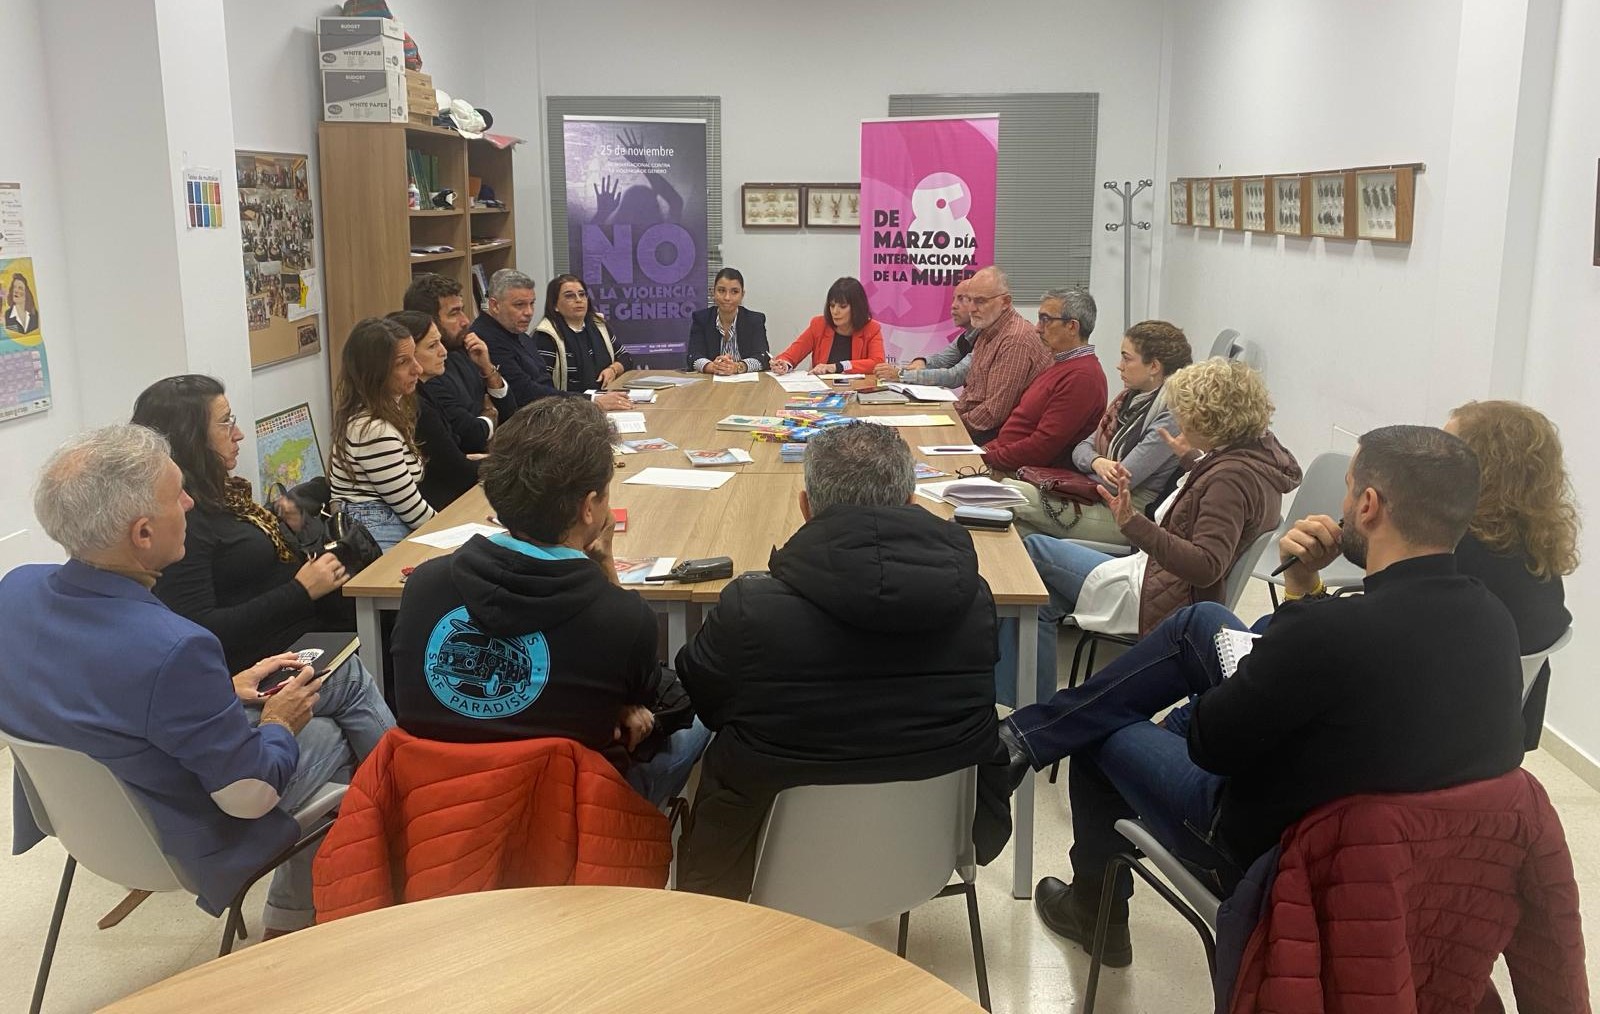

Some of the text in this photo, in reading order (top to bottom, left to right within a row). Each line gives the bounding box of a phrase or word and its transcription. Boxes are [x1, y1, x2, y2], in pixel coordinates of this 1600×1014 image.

[600, 145, 674, 157] 25 de noviembre
[874, 209, 900, 228] DE
[873, 230, 978, 250] MARZO DÍA
[582, 222, 696, 285] NO
[873, 253, 978, 266] INTERNACIONAL
[873, 270, 890, 282] DE
[892, 271, 908, 282] LA
[600, 287, 617, 300] LA
[622, 285, 697, 299] VIOLENCIA
[614, 299, 697, 321] GÉNERO
[428, 652, 530, 713] SURF PARADISE
